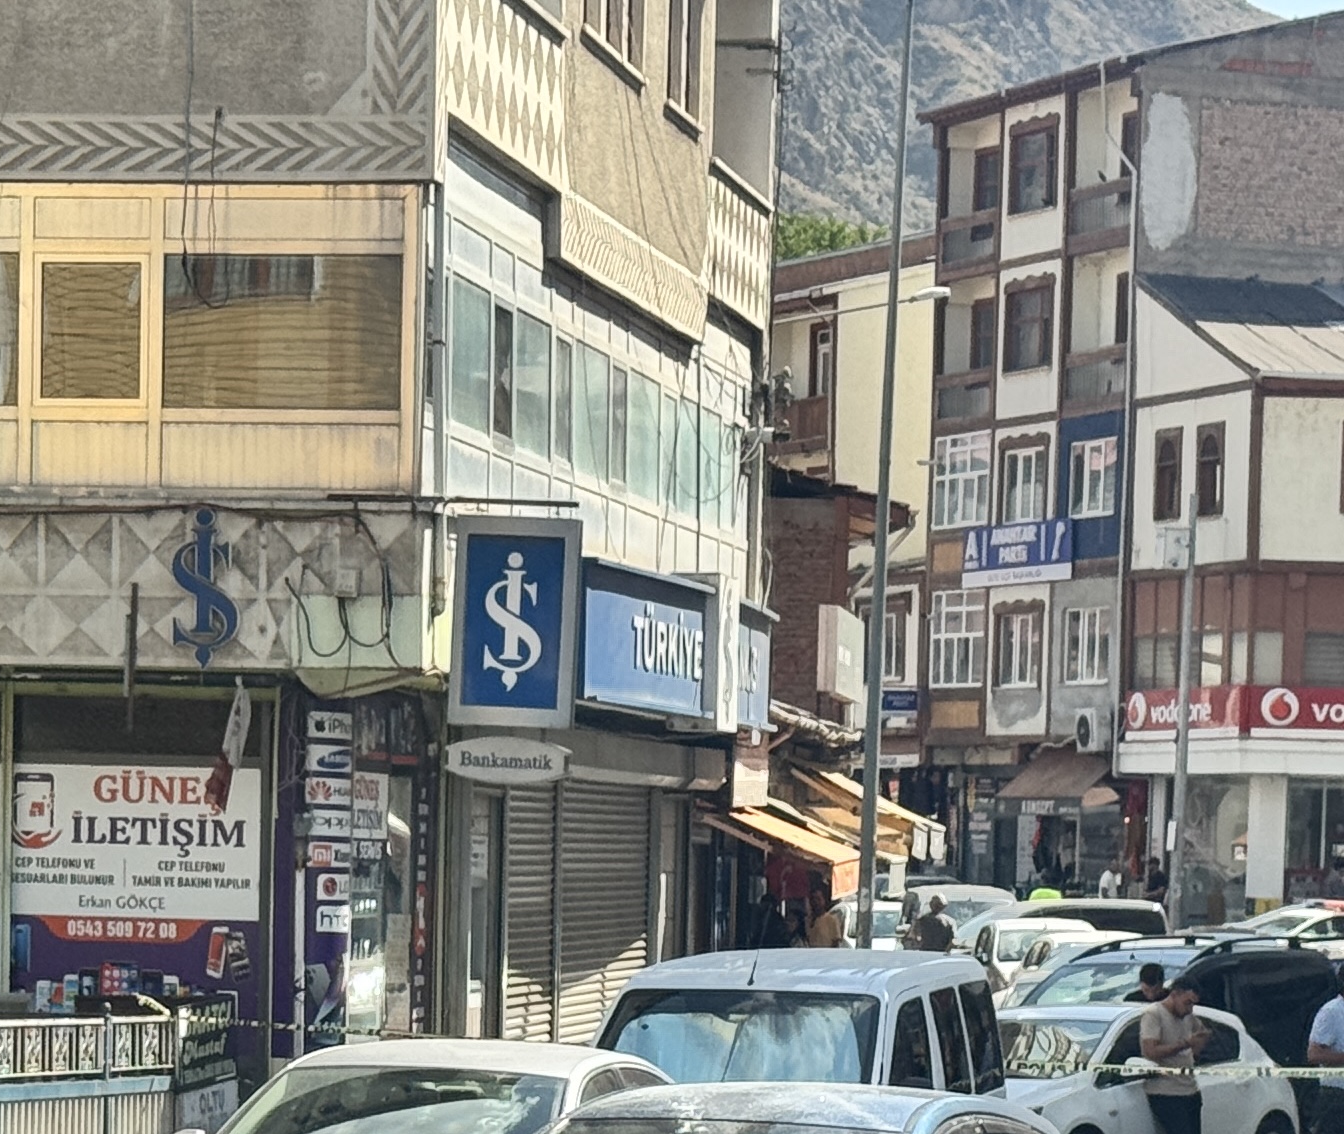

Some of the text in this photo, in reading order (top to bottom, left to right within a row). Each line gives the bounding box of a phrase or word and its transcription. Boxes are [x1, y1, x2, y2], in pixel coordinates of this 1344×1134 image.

[632, 601, 704, 680] TÜRKİYE
[459, 750, 553, 770] Bankamatik
[71, 810, 247, 858] İLETİŞİM
[15, 856, 96, 870] CEP TELEFONU VE
[158, 860, 226, 874] CEP TELEFONU
[70, 873, 115, 886] BULUNUR
[164, 876, 176, 888] VE
[213, 878, 251, 890] YAPILIR
[78, 894, 166, 913] Erkan GÖKÇE
[67, 919, 178, 939] 0543 509 72 08
